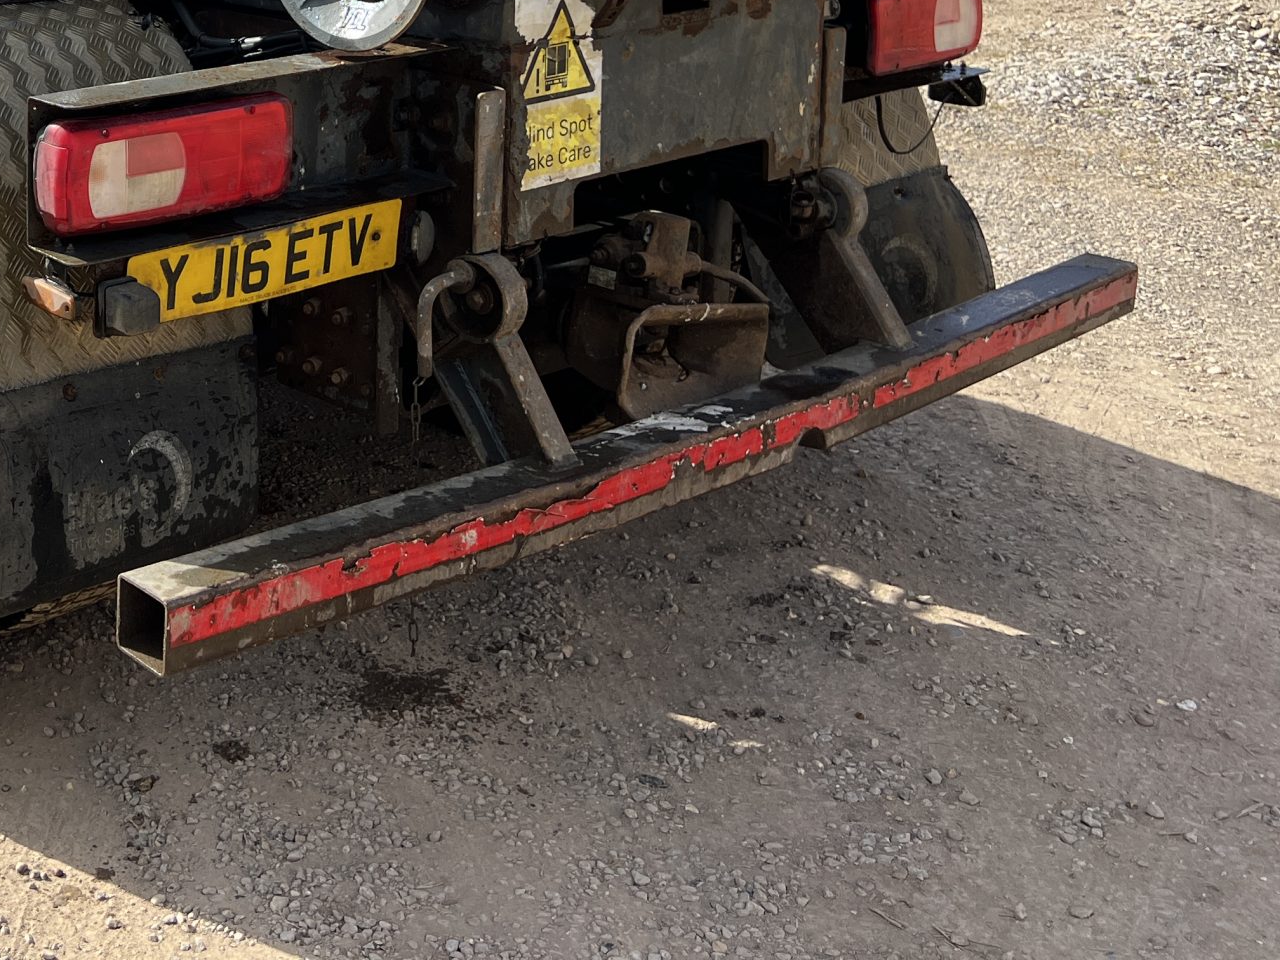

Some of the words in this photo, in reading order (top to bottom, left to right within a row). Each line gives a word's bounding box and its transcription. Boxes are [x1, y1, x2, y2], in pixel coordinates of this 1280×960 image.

[528, 121, 555, 143] lind
[559, 113, 593, 139] Spot
[528, 153, 554, 171] ake
[558, 145, 592, 165] Care
[159, 239, 272, 311] YJ16
[284, 213, 373, 285] ETV
